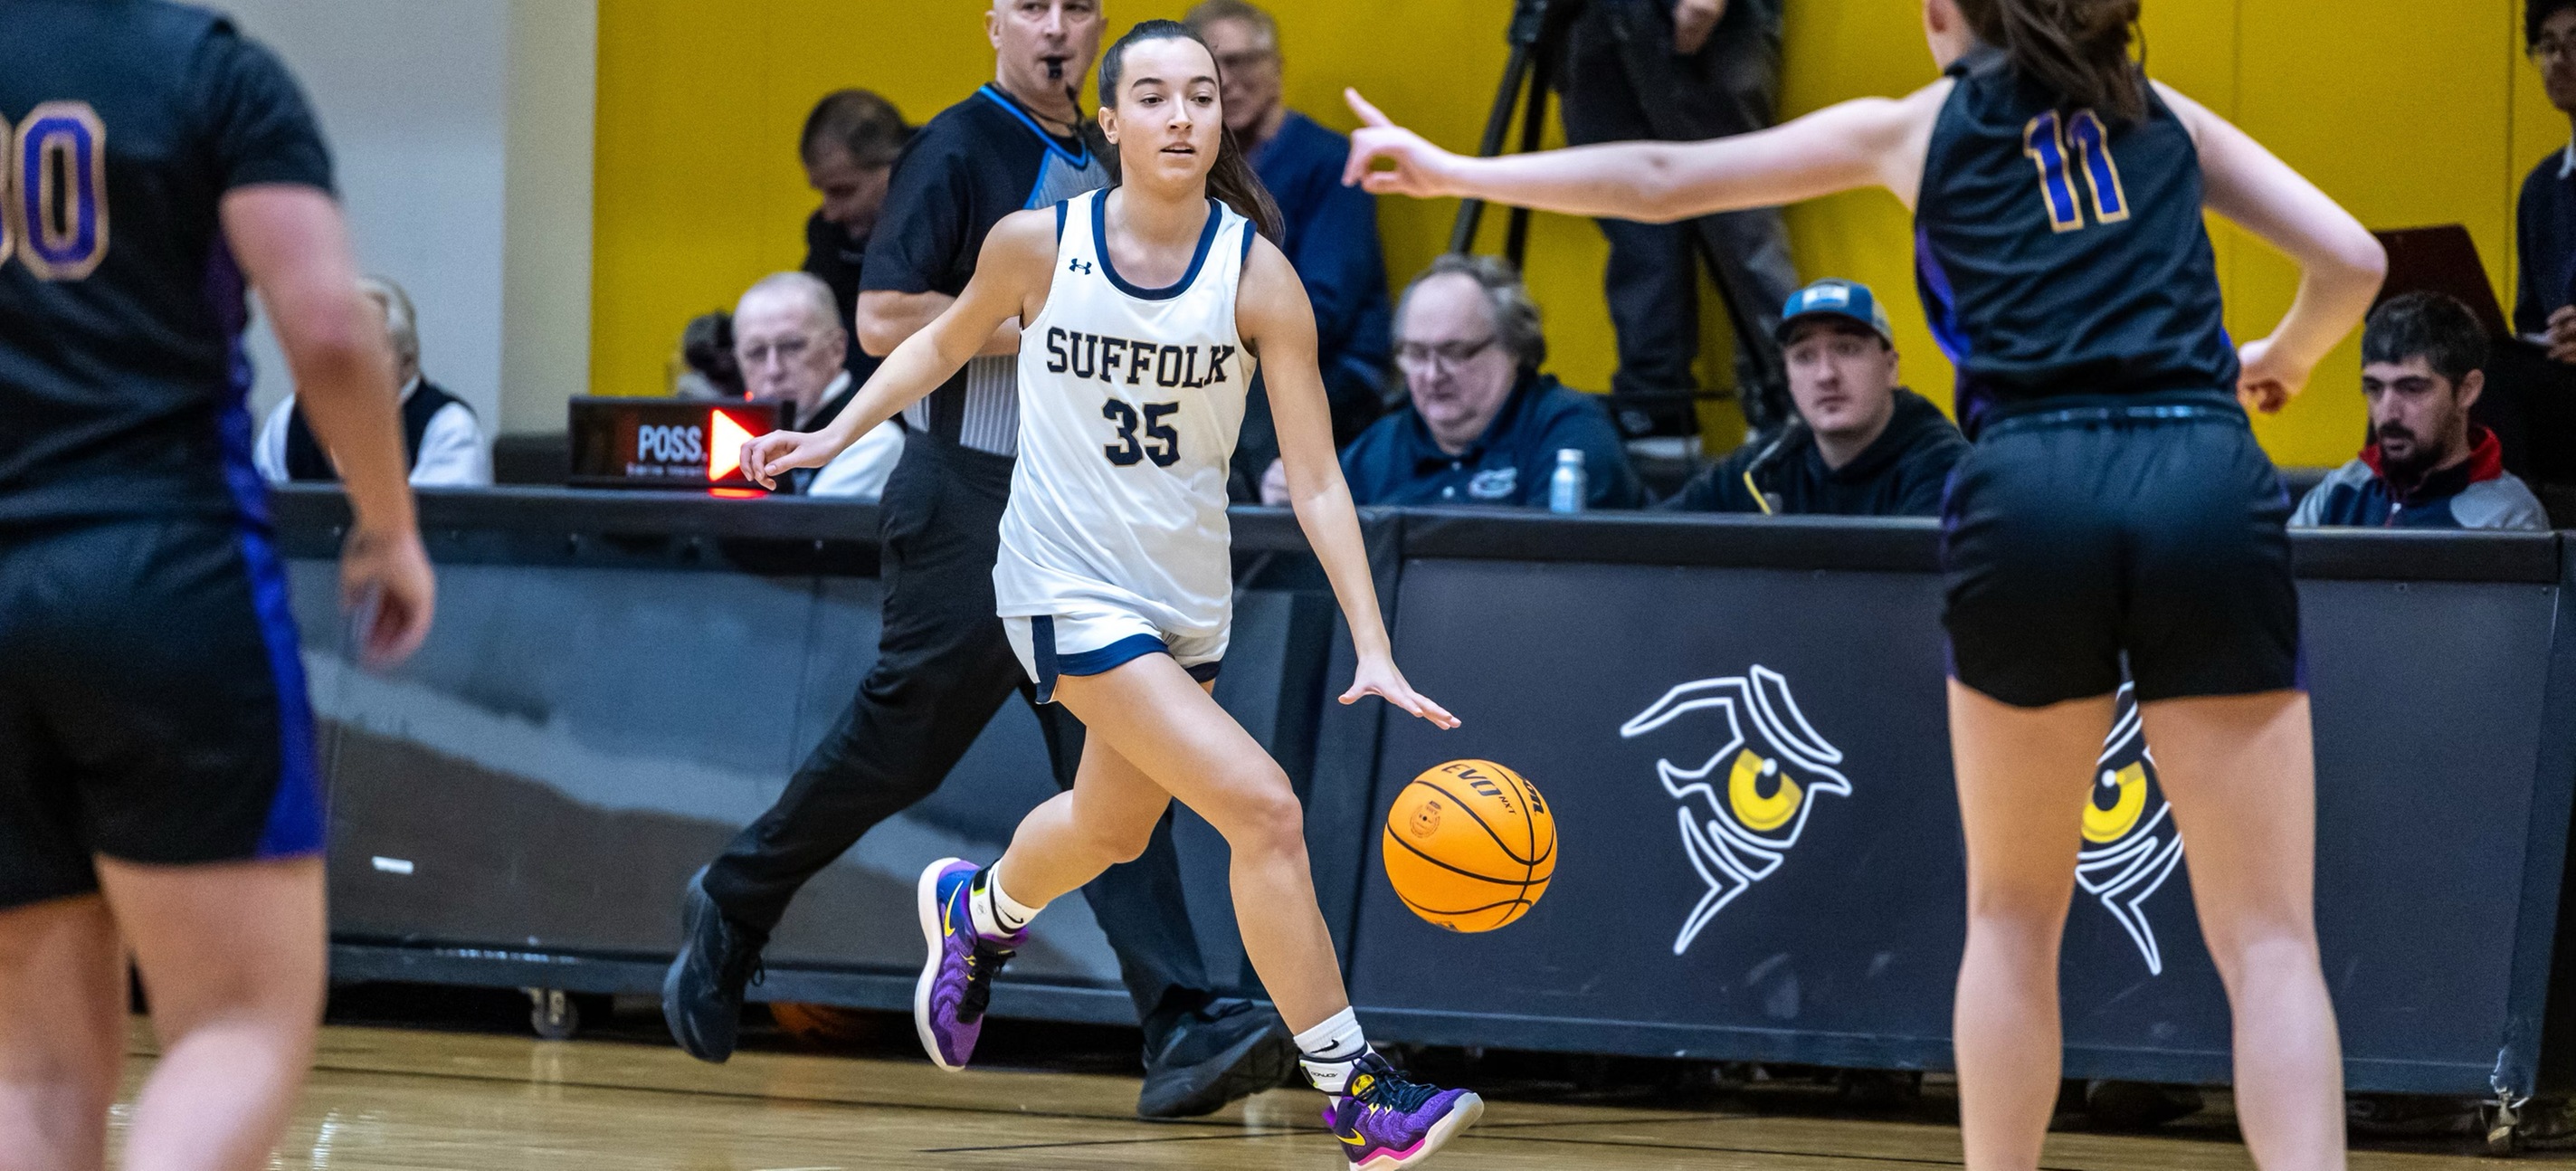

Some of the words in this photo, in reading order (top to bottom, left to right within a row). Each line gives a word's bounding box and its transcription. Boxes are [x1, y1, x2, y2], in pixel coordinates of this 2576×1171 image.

[0, 100, 109, 281] 0
[2023, 109, 2129, 233] 11
[1046, 327, 1235, 388] SUFFOLK
[1101, 396, 1180, 468] 35
[1441, 764, 1502, 796] EVO
[1498, 796, 1516, 814] NXT
